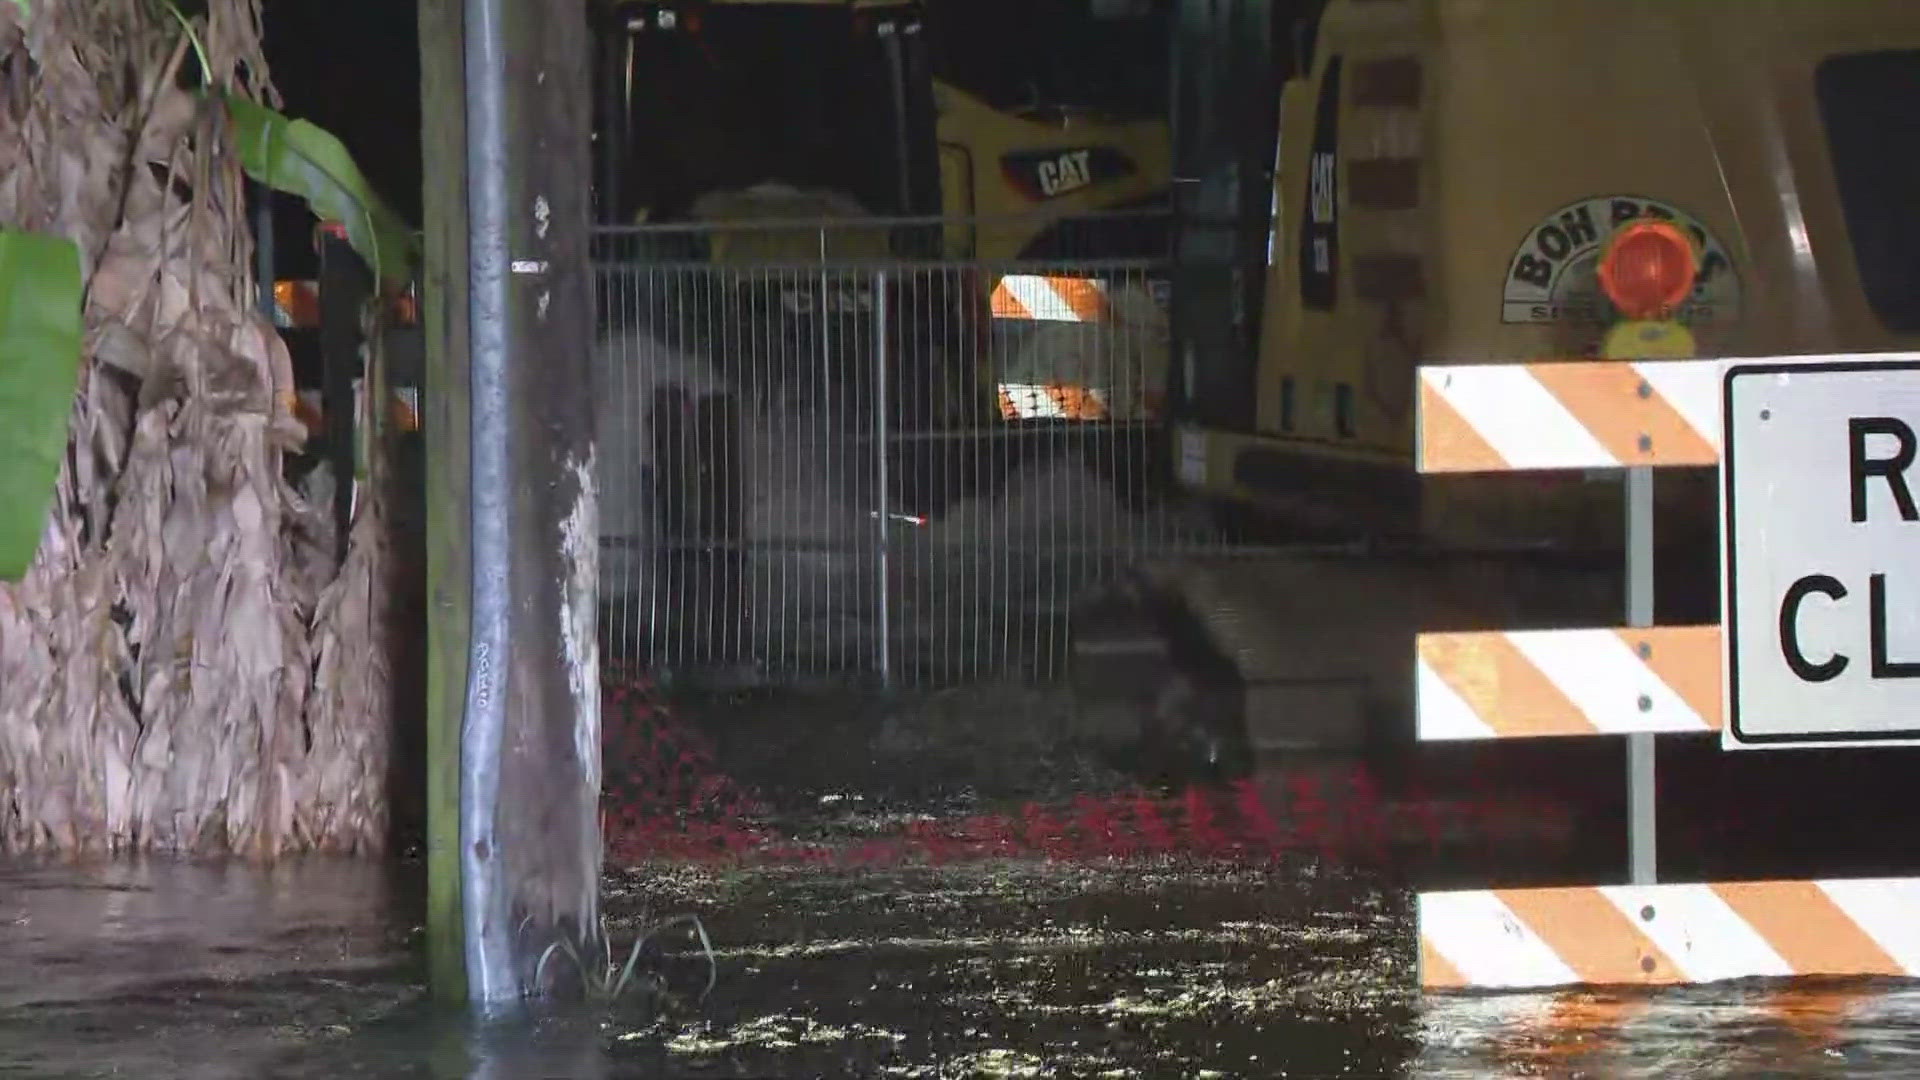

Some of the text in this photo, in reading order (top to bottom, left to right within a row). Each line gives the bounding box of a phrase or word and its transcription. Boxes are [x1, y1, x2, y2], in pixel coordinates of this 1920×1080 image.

[1039, 150, 1091, 196] CAT
[1311, 152, 1335, 223] CAT
[1514, 204, 1598, 288] BOH
